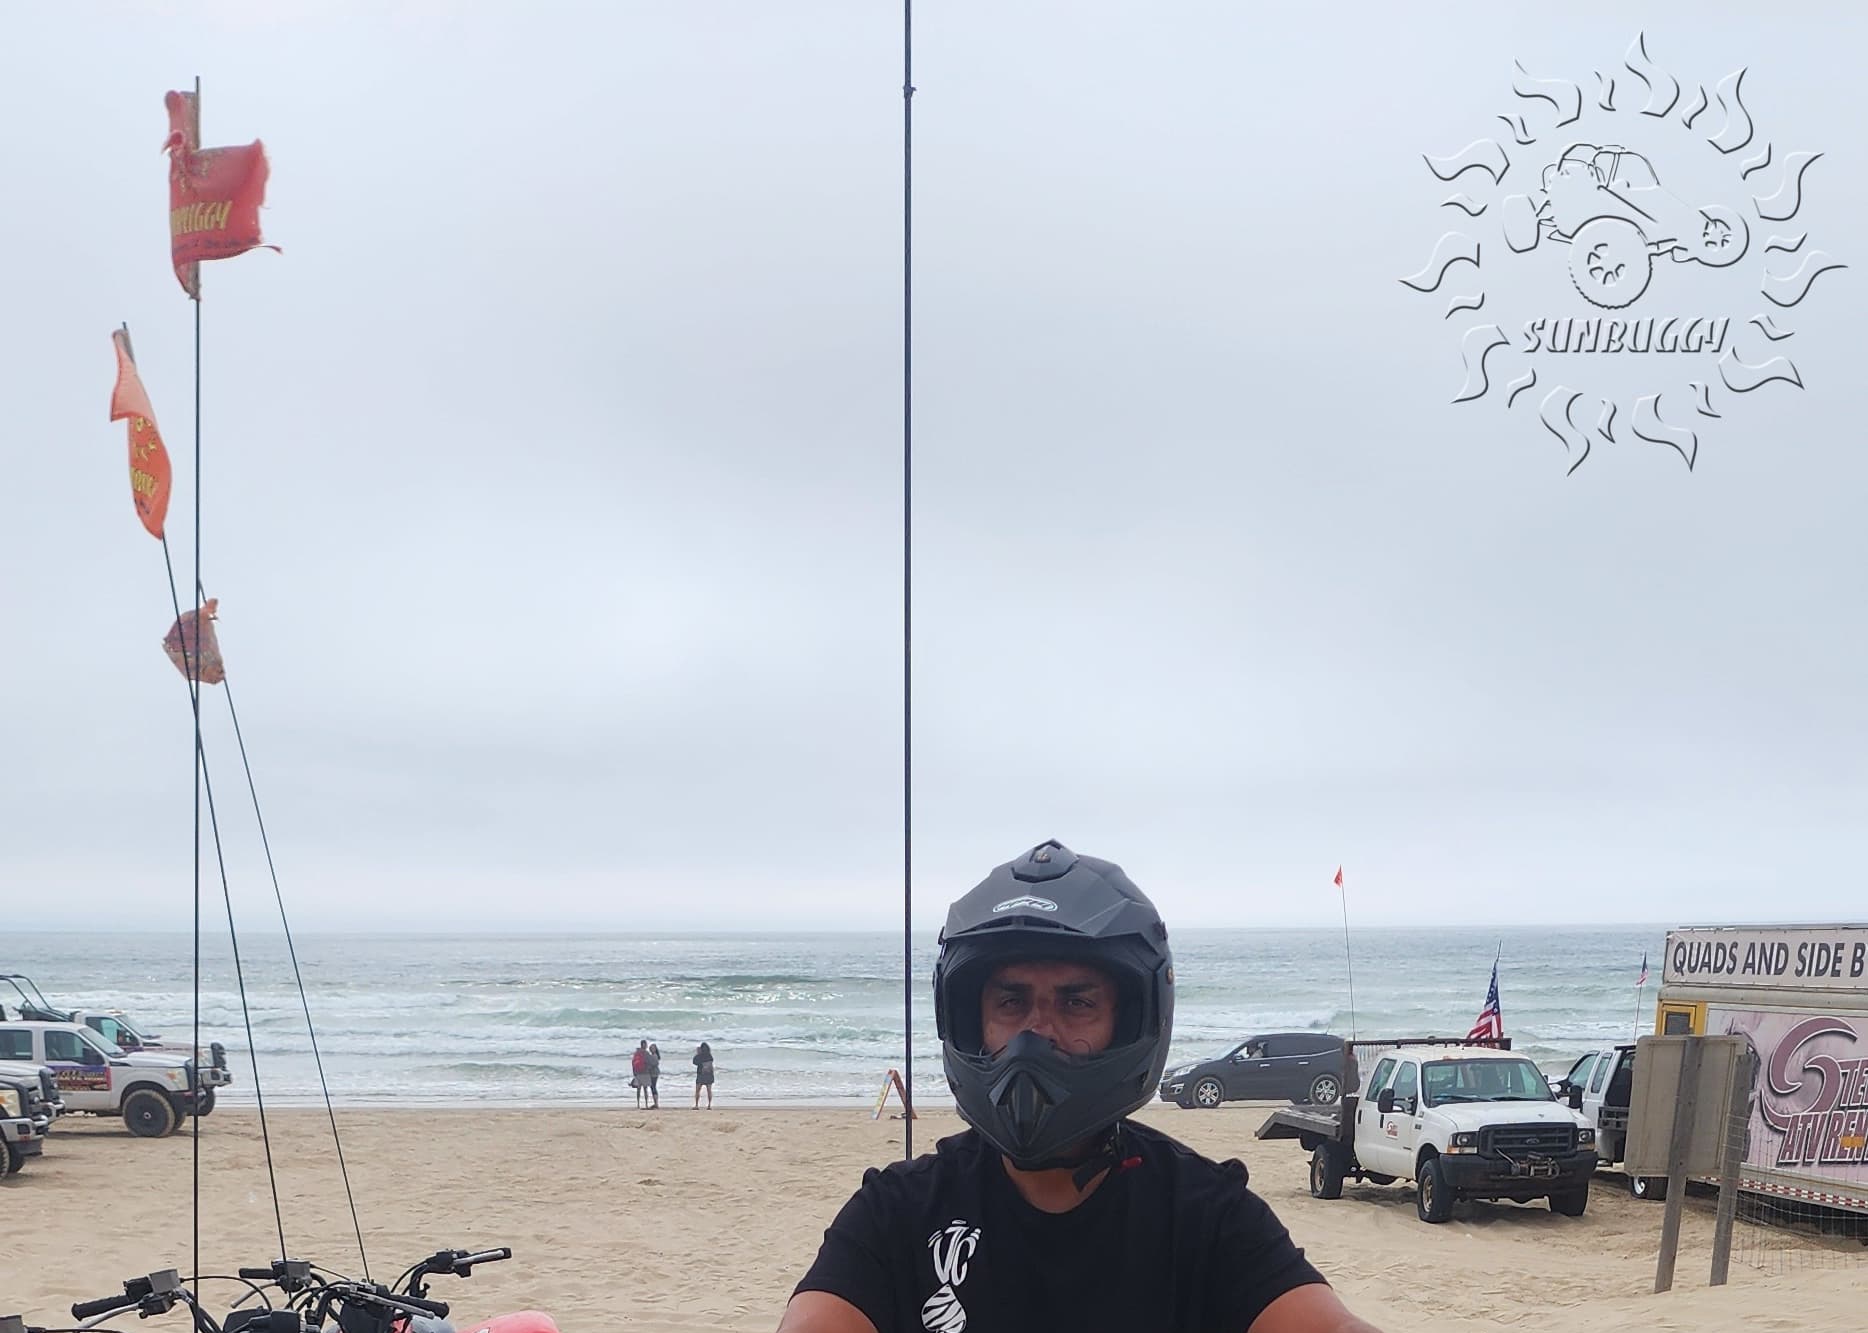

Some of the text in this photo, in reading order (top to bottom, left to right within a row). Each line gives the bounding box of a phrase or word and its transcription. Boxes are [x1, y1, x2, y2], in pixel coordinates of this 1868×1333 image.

[1673, 941, 1739, 976] QUADS
[1741, 942, 1790, 976] AND
[1794, 941, 1846, 978] SIDE
[1778, 1113, 1831, 1163] ATV
